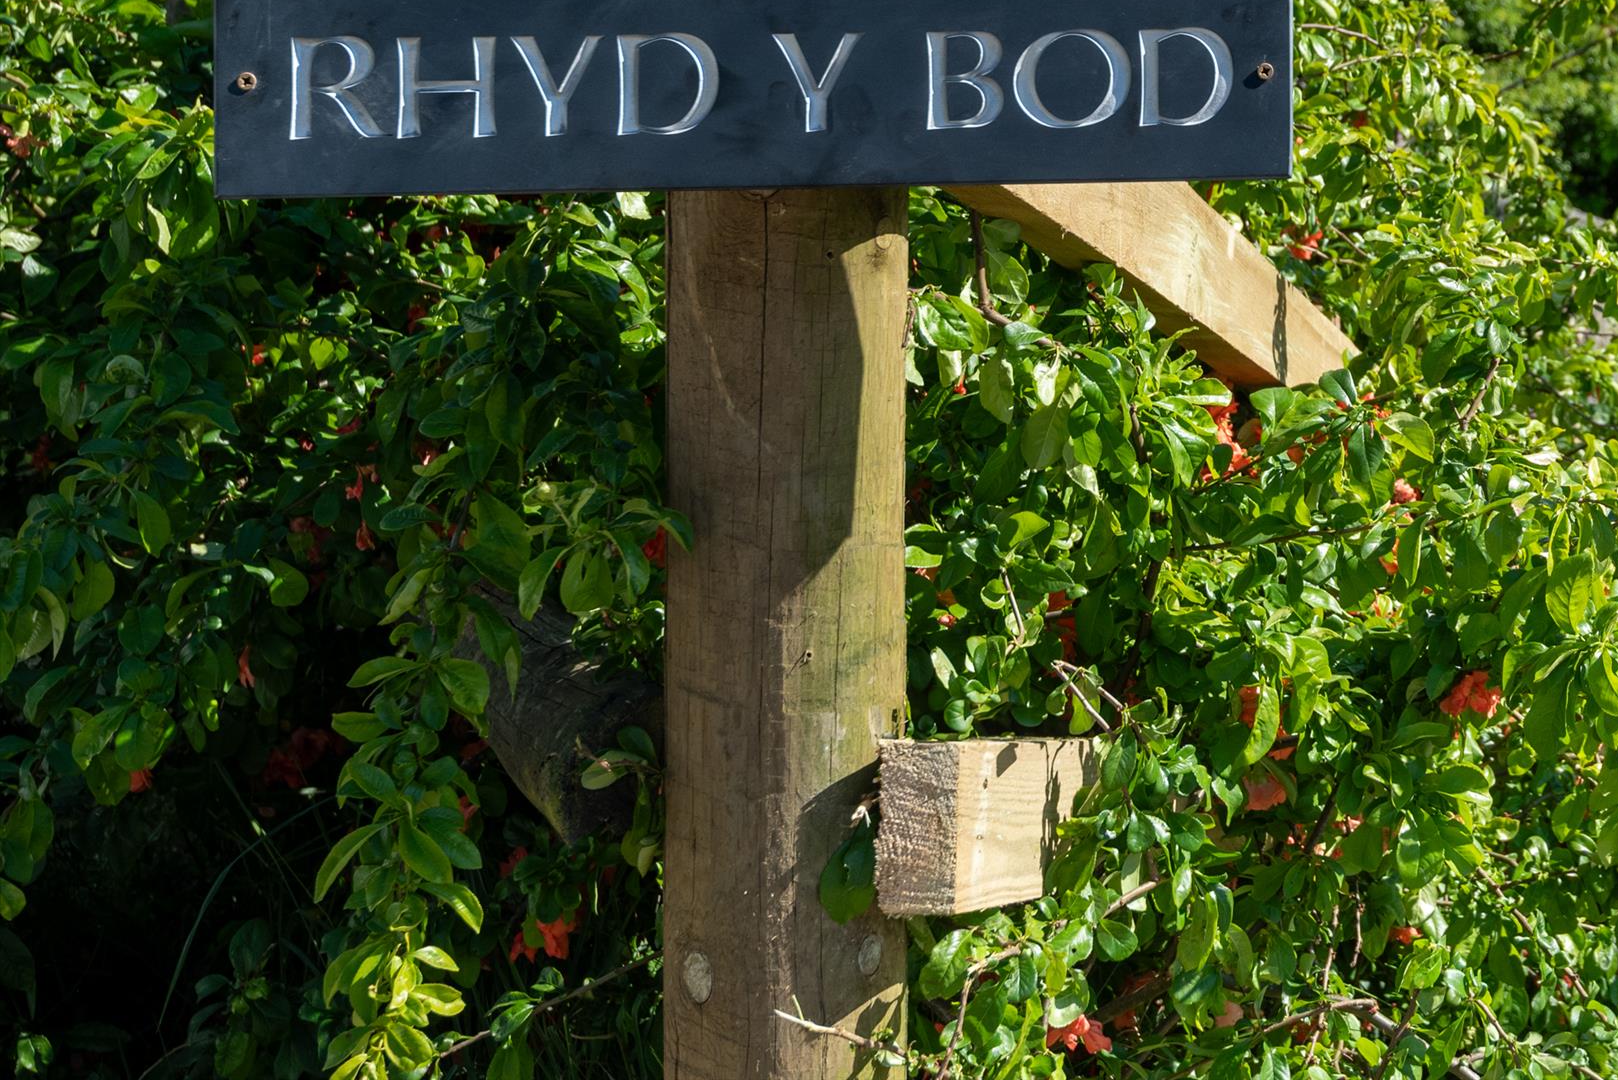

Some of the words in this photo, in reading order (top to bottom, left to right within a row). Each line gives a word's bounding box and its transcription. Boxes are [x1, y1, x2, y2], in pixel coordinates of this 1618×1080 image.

[288, 33, 720, 141] RHYD
[772, 32, 865, 133] Y
[925, 27, 1235, 131] BOD
